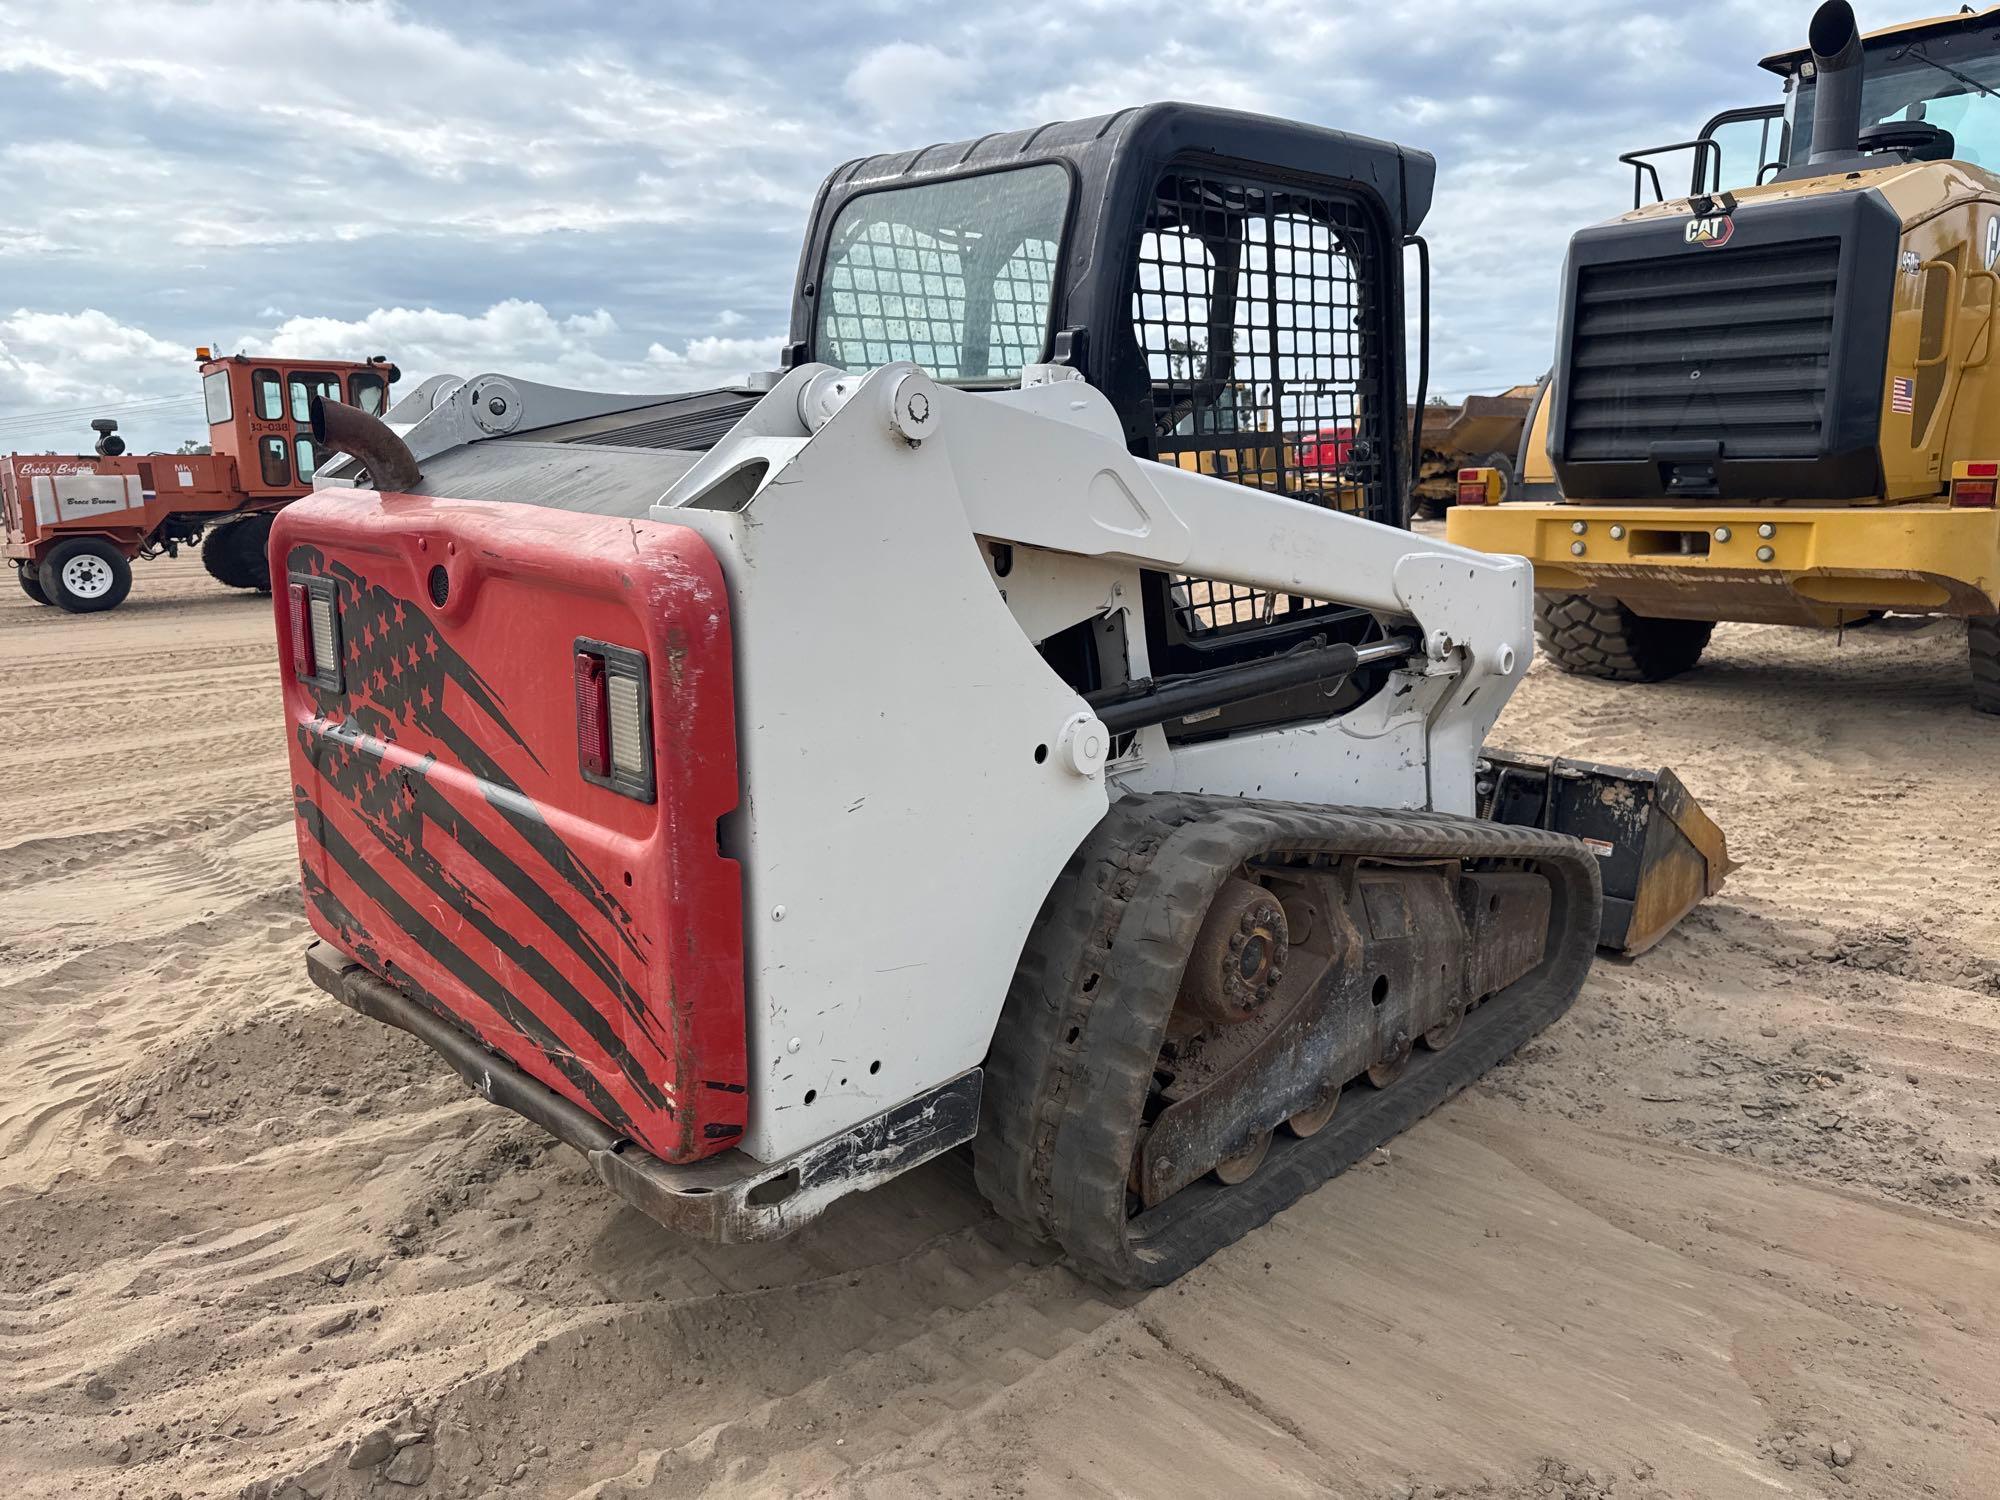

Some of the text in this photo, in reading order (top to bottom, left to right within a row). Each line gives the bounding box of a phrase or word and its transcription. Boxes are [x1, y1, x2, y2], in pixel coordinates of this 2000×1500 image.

[1686, 217, 1723, 242] CAT
[20, 463, 51, 474] Broce
[67, 497, 117, 505] Broce Broom
